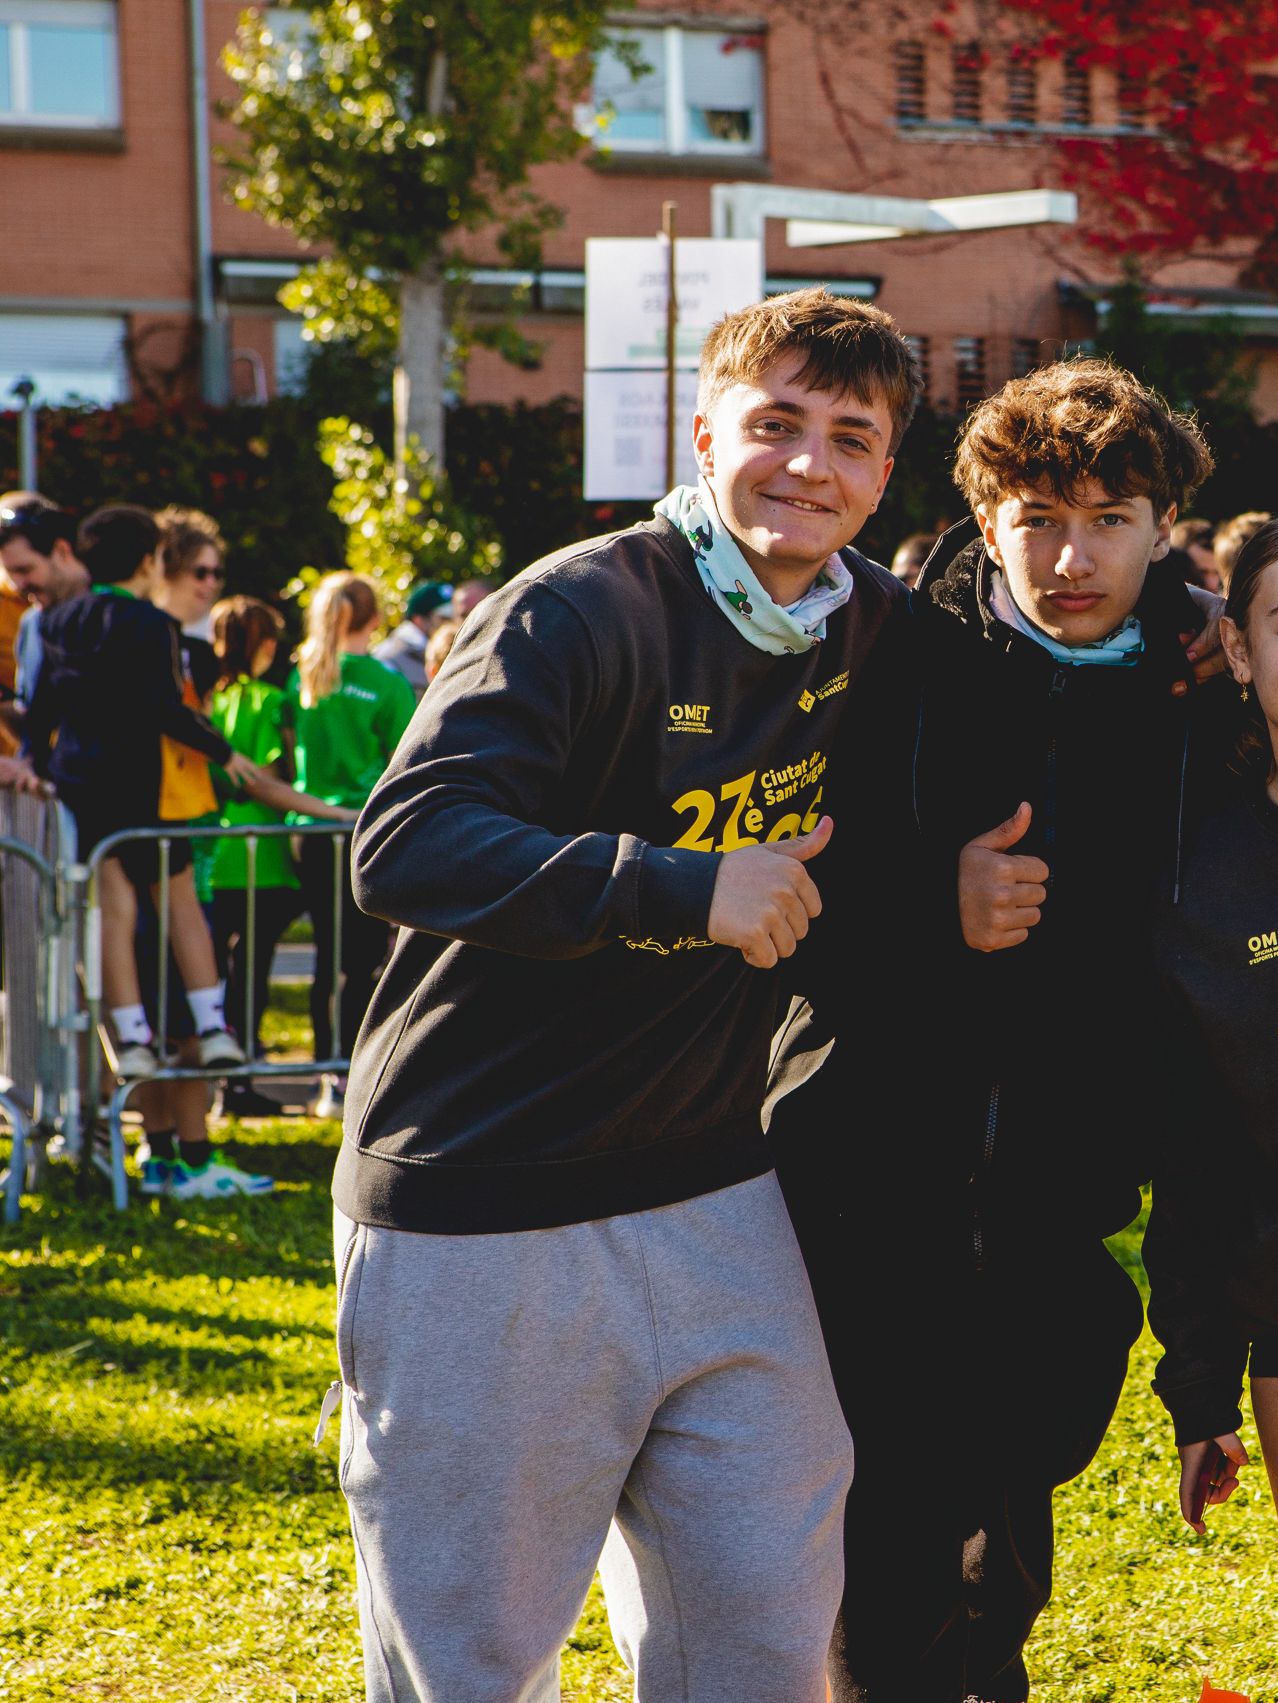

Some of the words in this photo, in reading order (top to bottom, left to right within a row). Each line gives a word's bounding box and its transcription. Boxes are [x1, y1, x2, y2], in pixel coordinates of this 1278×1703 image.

[817, 678, 849, 701] SantCu
[669, 704, 711, 721] OMET
[761, 759, 808, 789] Ciutat
[764, 780, 798, 806] Sant
[800, 755, 827, 789] Cugat
